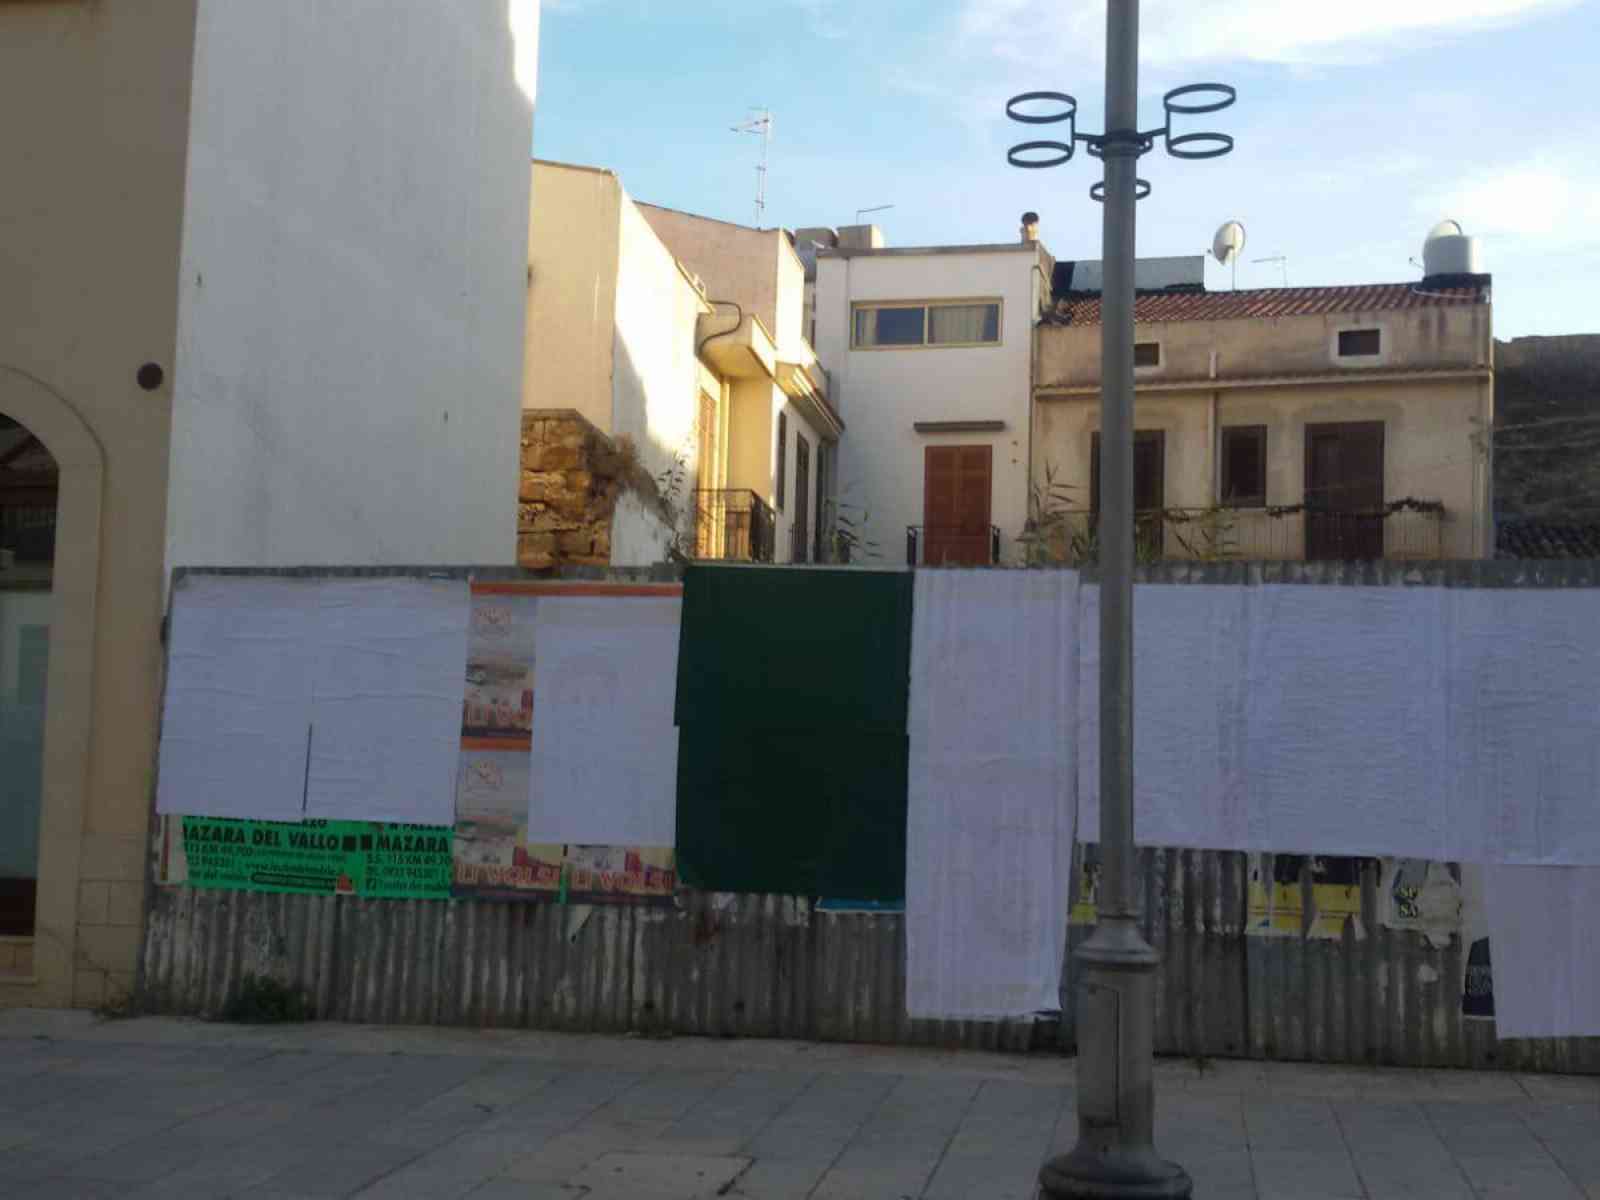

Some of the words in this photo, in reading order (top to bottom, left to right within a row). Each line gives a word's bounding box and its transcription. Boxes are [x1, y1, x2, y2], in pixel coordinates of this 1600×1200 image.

[252, 829, 280, 846] DEL
[288, 832, 338, 851] VALLO
[375, 834, 449, 853] MAZARA
